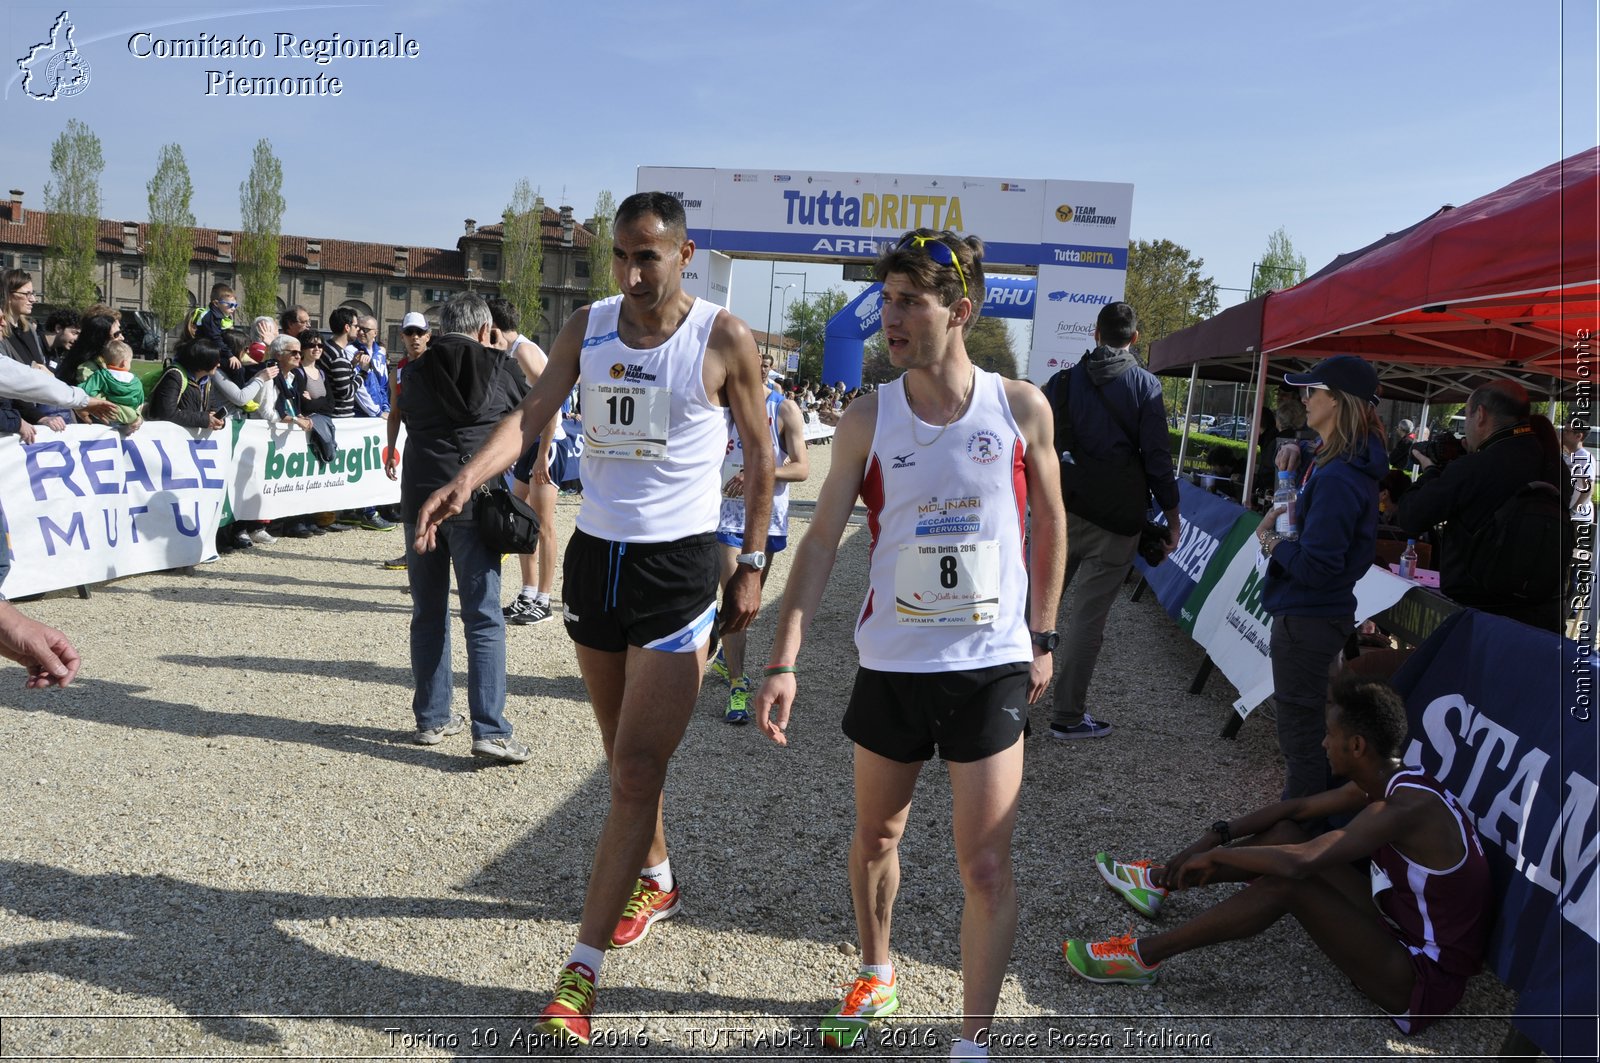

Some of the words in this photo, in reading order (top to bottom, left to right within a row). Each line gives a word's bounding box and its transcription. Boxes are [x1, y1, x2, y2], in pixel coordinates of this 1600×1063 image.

[783, 190, 964, 232] TuttaDRITTA
[1075, 206, 1096, 215] TEAM
[1073, 215, 1117, 225] MARATHON
[1054, 249, 1114, 265] TuttaDRITTA
[984, 287, 1034, 306] ARHU
[1068, 293, 1113, 305] KARHU
[859, 311, 882, 332] KARH
[1056, 321, 1096, 334] fiorfood
[627, 364, 643, 372] TEAM
[625, 370, 657, 382] MARATHON
[598, 385, 612, 394] Tutta
[613, 386, 630, 394] Dritta
[631, 387, 646, 395] 2016
[606, 395, 635, 426] 10
[21, 437, 225, 502] REALE
[263, 484, 271, 494] la
[273, 483, 294, 496] frutta
[295, 481, 304, 491] ha
[323, 477, 344, 488] strada
[918, 500, 981, 514] MOLINARI
[929, 524, 978, 534] GERVASONI
[918, 546, 936, 554] Tutta
[938, 545, 958, 554] Dritta
[960, 544, 976, 552] 2016
[940, 555, 958, 589] 8
[1403, 693, 1600, 943] STAM
